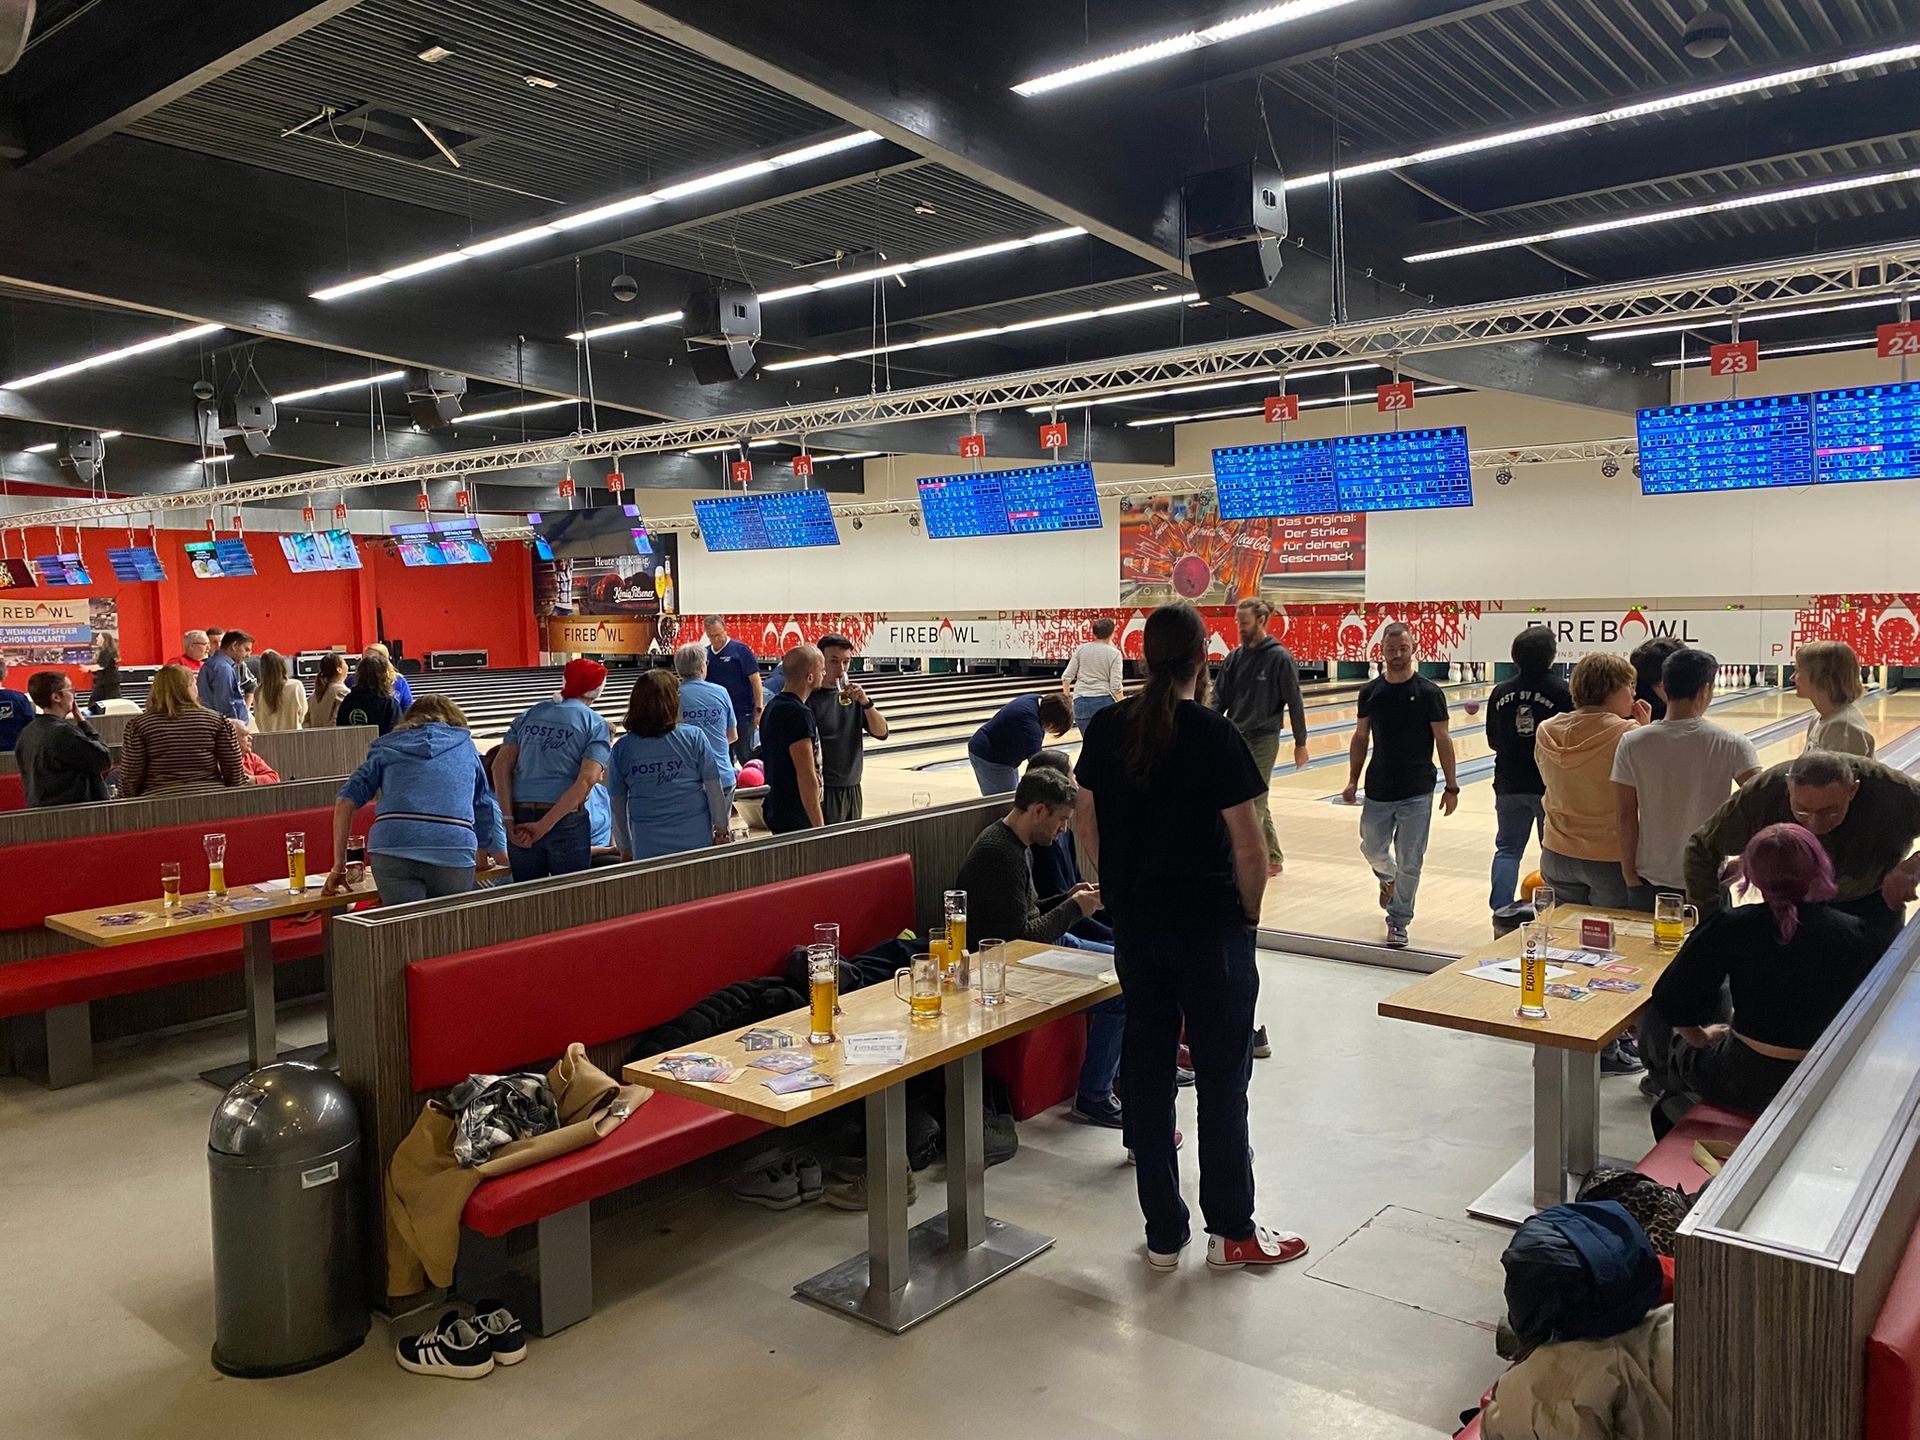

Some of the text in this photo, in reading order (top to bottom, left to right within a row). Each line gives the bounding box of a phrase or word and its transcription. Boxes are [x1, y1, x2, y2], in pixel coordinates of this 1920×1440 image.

[1888, 335, 1920, 355] 24
[1720, 356, 1748, 374] 23
[1385, 395, 1407, 410] 22
[1271, 407, 1292, 421] 21
[1046, 433, 1062, 447] 20
[965, 444, 980, 457] 19
[736, 470, 747, 481] 17
[797, 464, 809, 476] 18
[562, 487, 572, 497] 15
[611, 481, 621, 491] 16
[1277, 513, 1357, 527] Das Original:
[1284, 527, 1349, 539] Der Strike
[1283, 540, 1350, 551] für deinen
[594, 556, 615, 567] Heute
[1279, 551, 1354, 564] Geschmack
[3, 602, 74, 619] REBOWL
[5, 627, 78, 636] WEIHNACHTSFEIER
[564, 620, 625, 642] FIREBOWL
[890, 617, 980, 643] FIREBOWL
[1527, 608, 1699, 643] REBOWL
[27, 635, 66, 643] GEPLANT?
[683, 708, 723, 720] POST SV
[524, 725, 576, 740] POST SV
[631, 760, 684, 776] POST SV
[1525, 948, 1537, 992] ERDINGER
